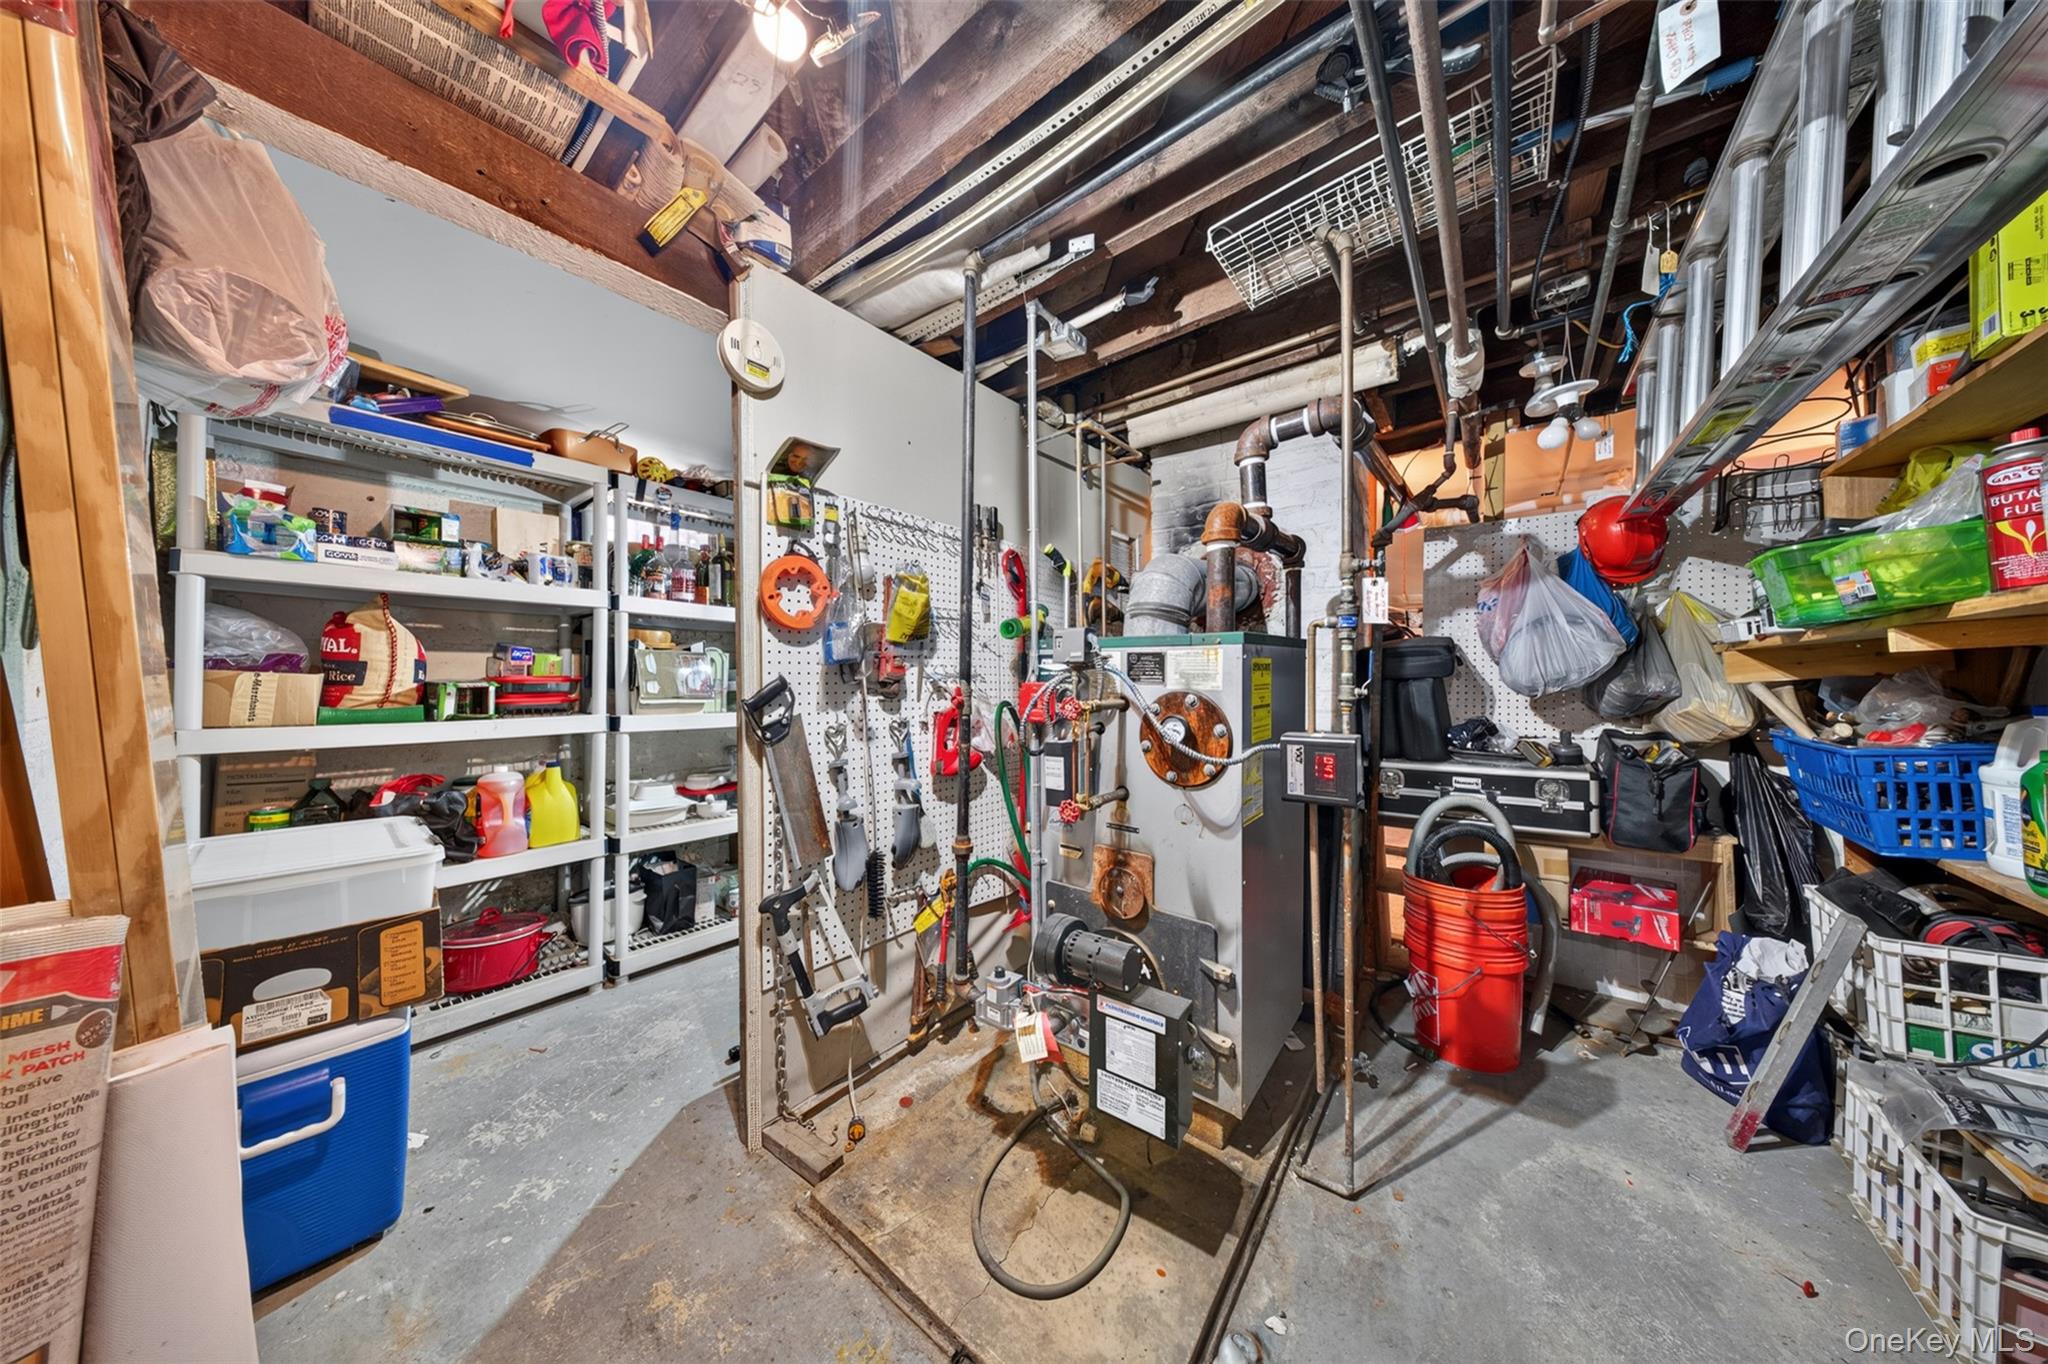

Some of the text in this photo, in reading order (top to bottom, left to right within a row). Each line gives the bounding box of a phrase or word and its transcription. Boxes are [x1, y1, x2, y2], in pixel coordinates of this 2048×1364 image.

[328, 670, 356, 681] Rice
[8, 1040, 71, 1065] MESH
[21, 1050, 85, 1076] PATCH
[6, 1099, 70, 1125] Interior
[53, 1104, 84, 1120] with
[16, 1120, 70, 1143] Cracks
